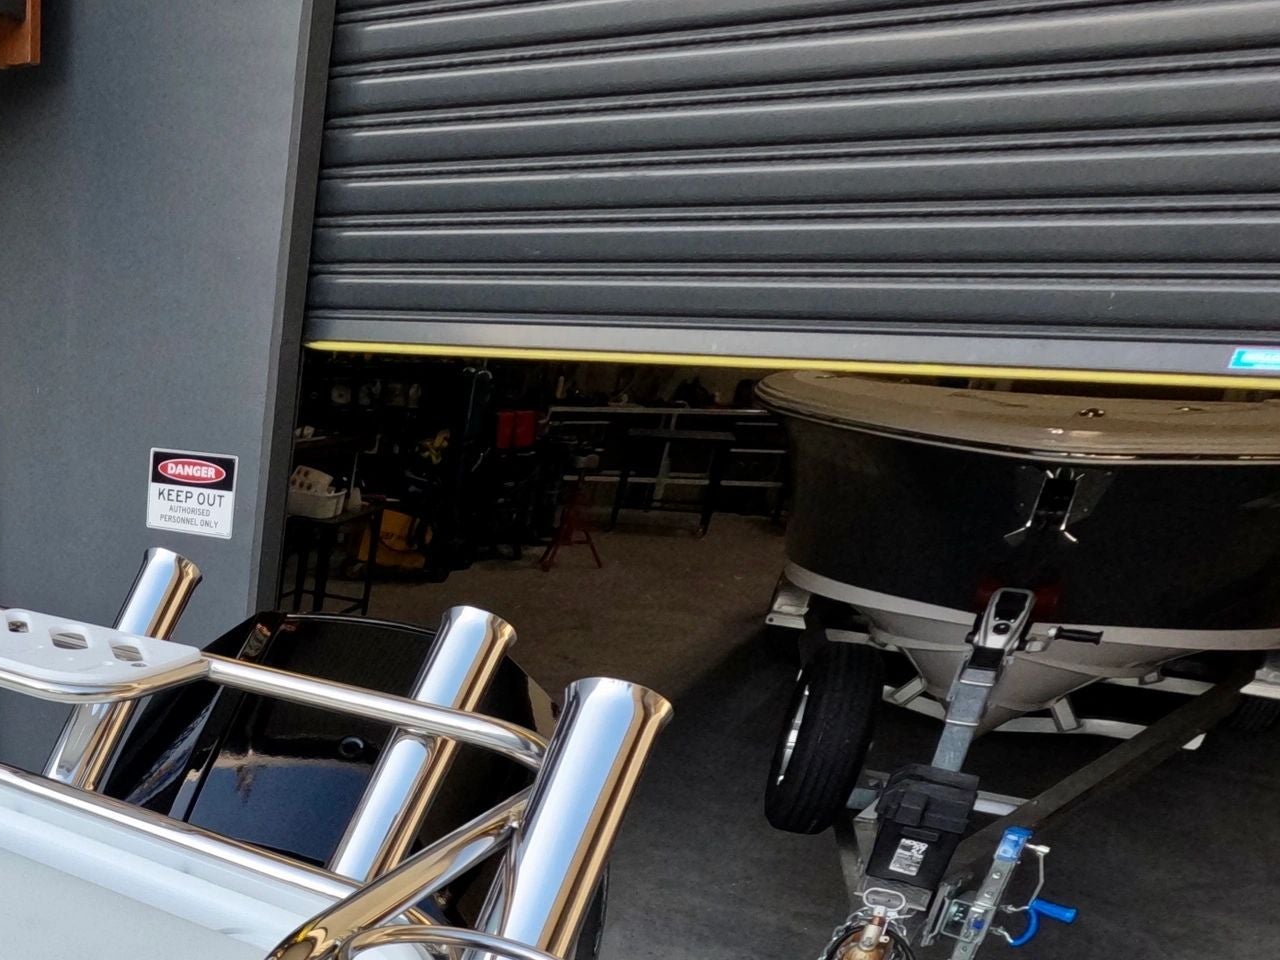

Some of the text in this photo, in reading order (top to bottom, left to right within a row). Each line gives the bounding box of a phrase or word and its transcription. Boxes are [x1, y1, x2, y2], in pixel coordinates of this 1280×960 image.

[167, 463, 216, 478] DANGER
[158, 487, 224, 508] KEEP OUT
[169, 505, 211, 517] AUTHORISED
[160, 513, 219, 528] PERSONNEL ONLY
